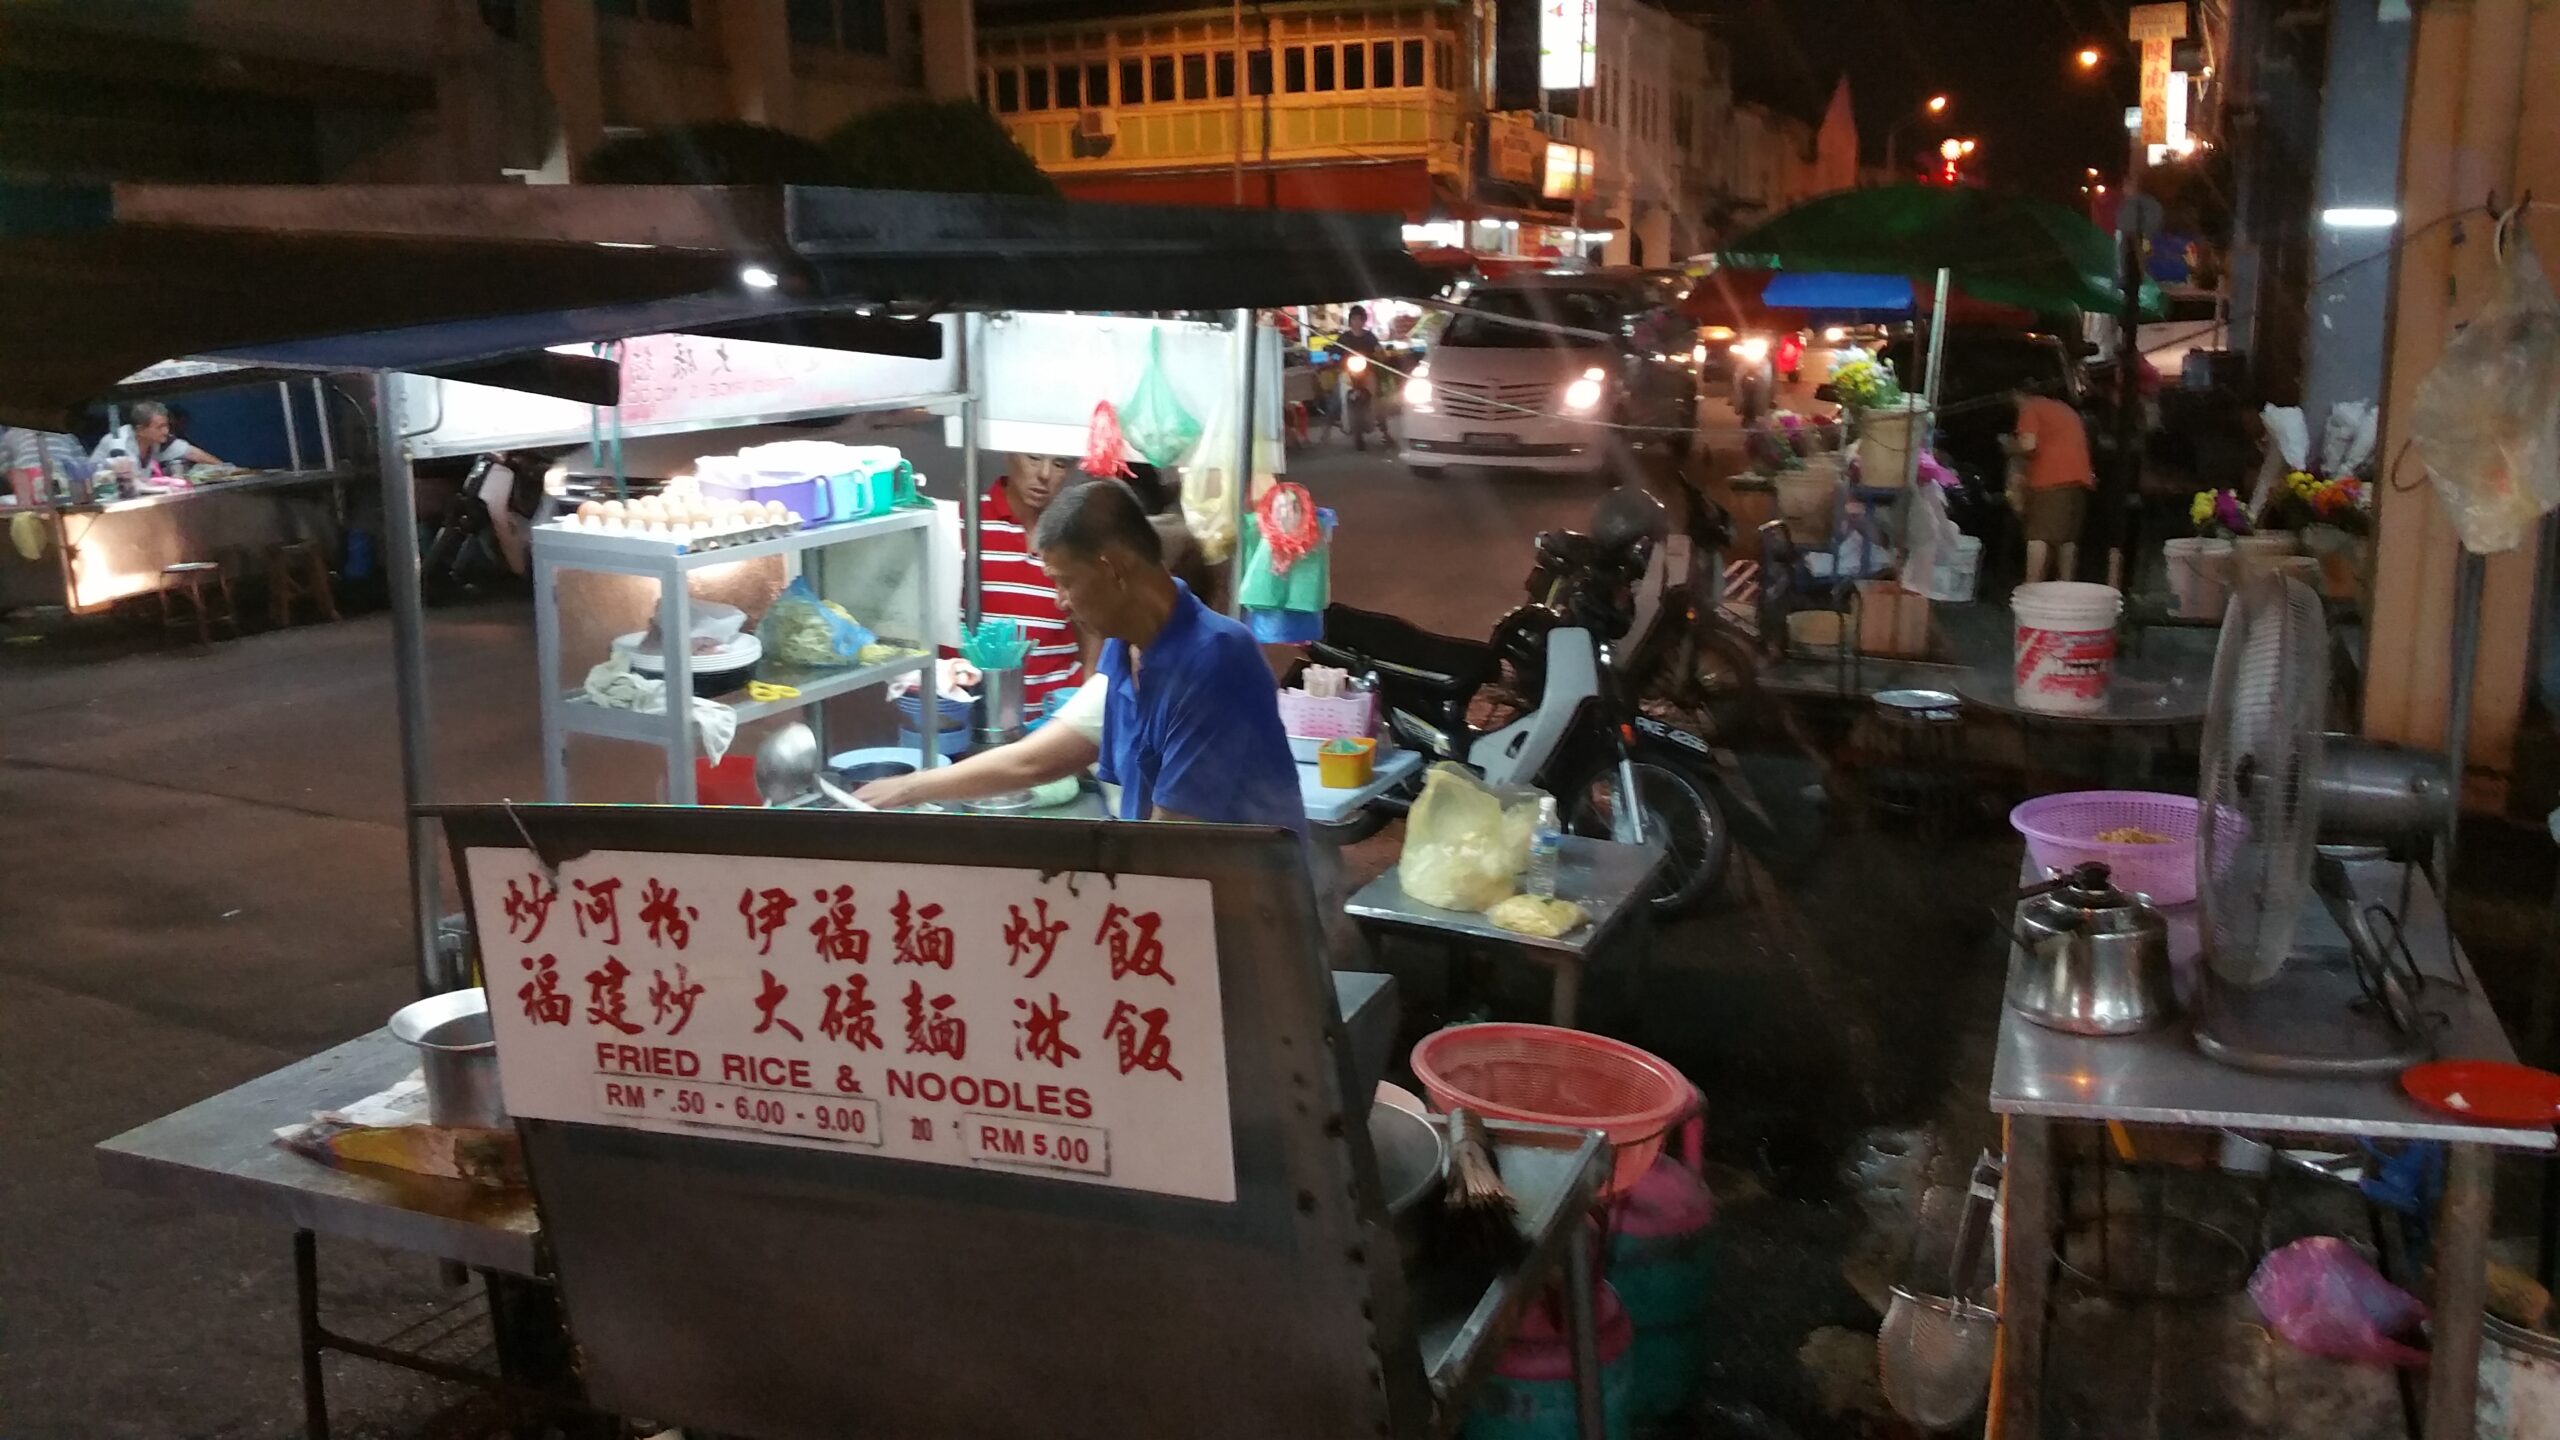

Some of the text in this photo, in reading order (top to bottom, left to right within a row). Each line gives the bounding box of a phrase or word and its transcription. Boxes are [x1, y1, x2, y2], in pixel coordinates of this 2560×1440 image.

[518, 953, 706, 1036] 福建炒
[595, 1042, 1093, 1119] FRIED RICE & NOODLES
[605, 1083, 646, 1108] RM
[735, 1096, 785, 1125] 6.00
[815, 1105, 865, 1133] 9.00
[980, 1125, 1089, 1164] RM 5.00
